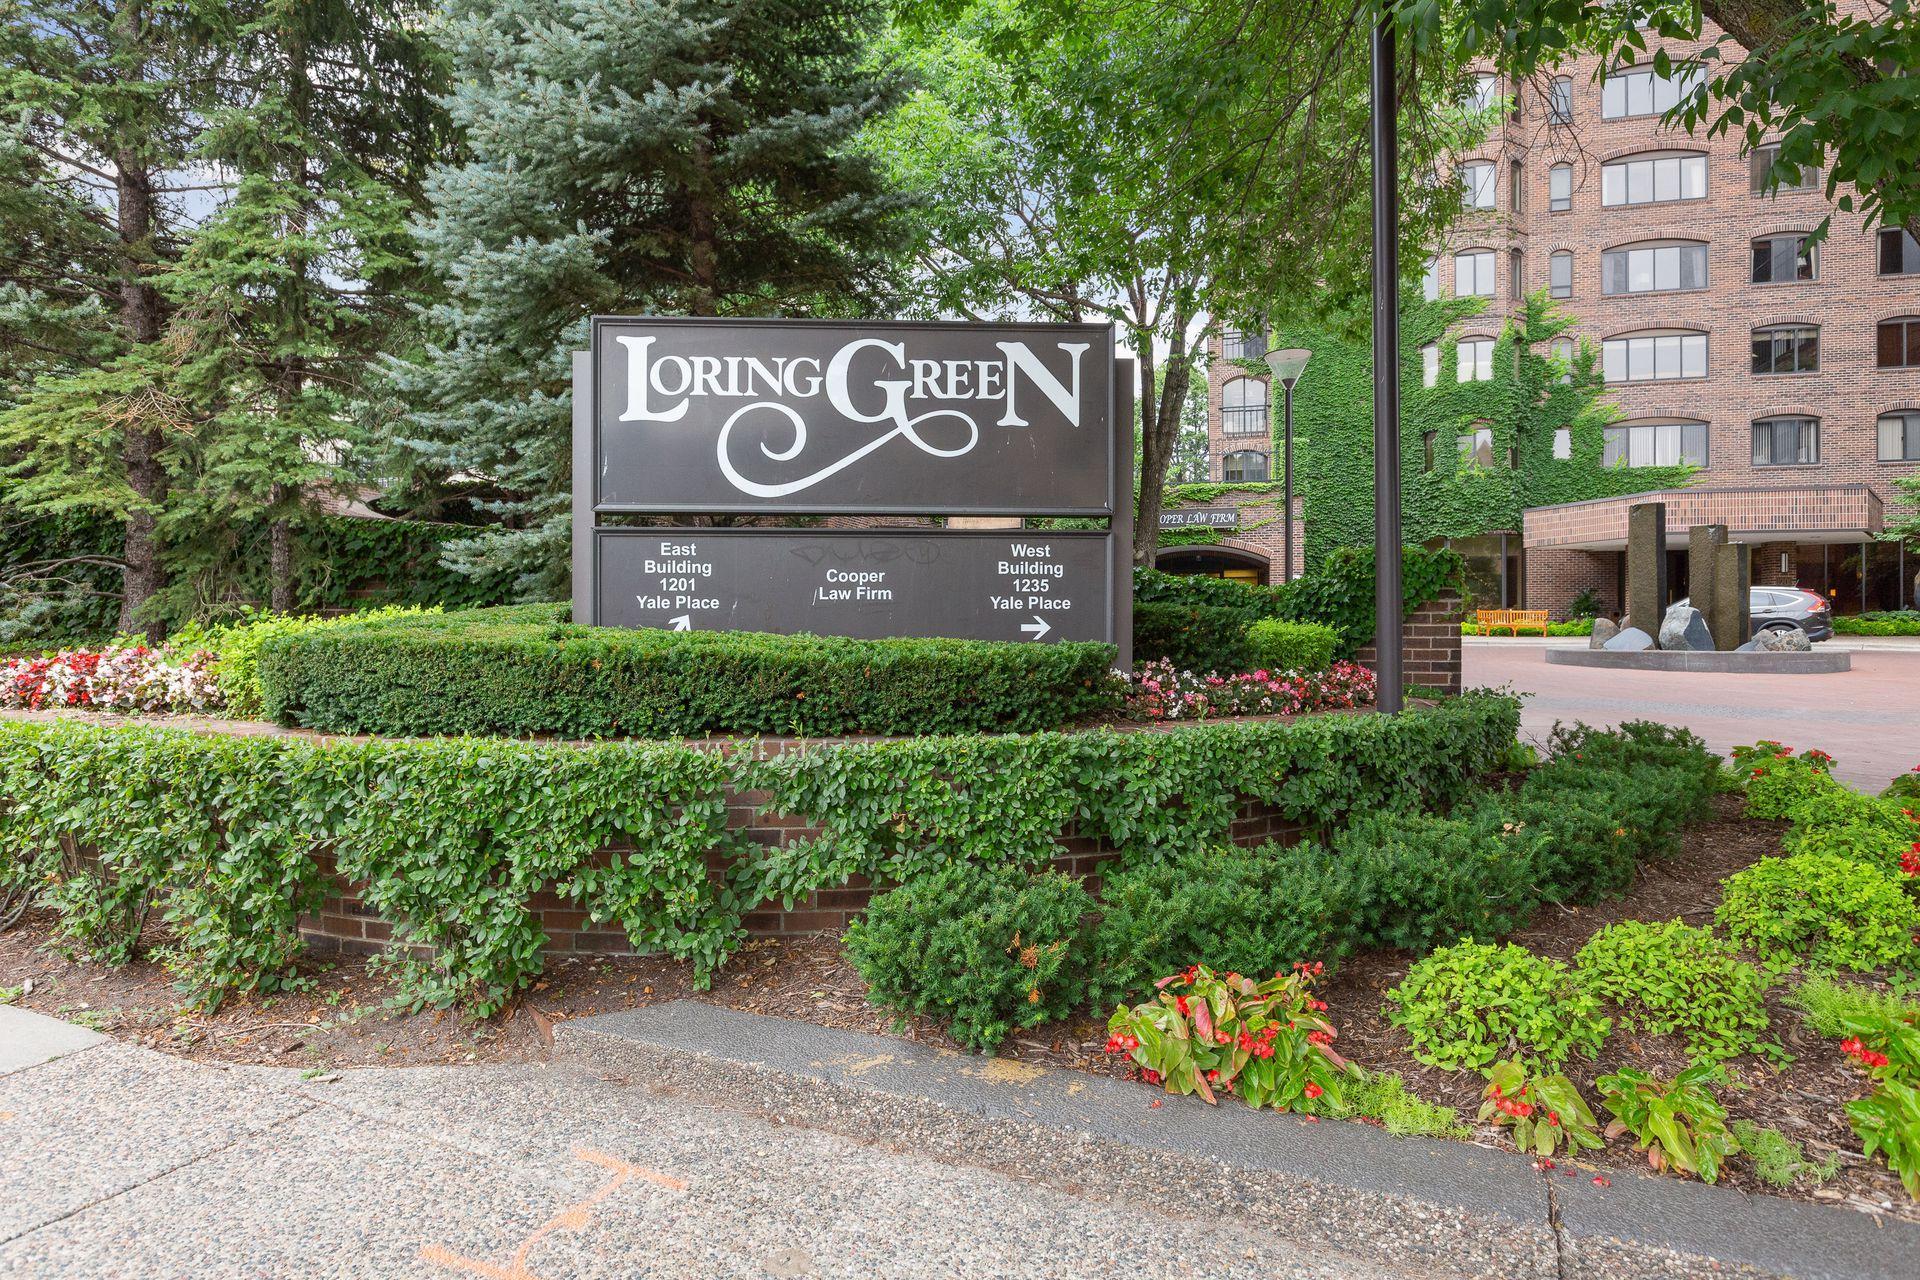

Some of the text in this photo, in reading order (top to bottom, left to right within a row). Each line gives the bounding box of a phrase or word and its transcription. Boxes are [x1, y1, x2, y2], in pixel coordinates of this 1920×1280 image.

[1160, 512, 1235, 524] OPER LAW FIRM
[661, 542, 697, 556] East
[1011, 544, 1050, 557] West
[645, 559, 712, 578] Building
[998, 561, 1063, 579] Building
[826, 569, 885, 585] Cooper
[660, 577, 695, 592] 1201
[1013, 579, 1049, 592] 1235
[819, 587, 893, 600] Law Firm
[636, 595, 719, 609] Yale Place
[990, 596, 1071, 609] Yale Place
